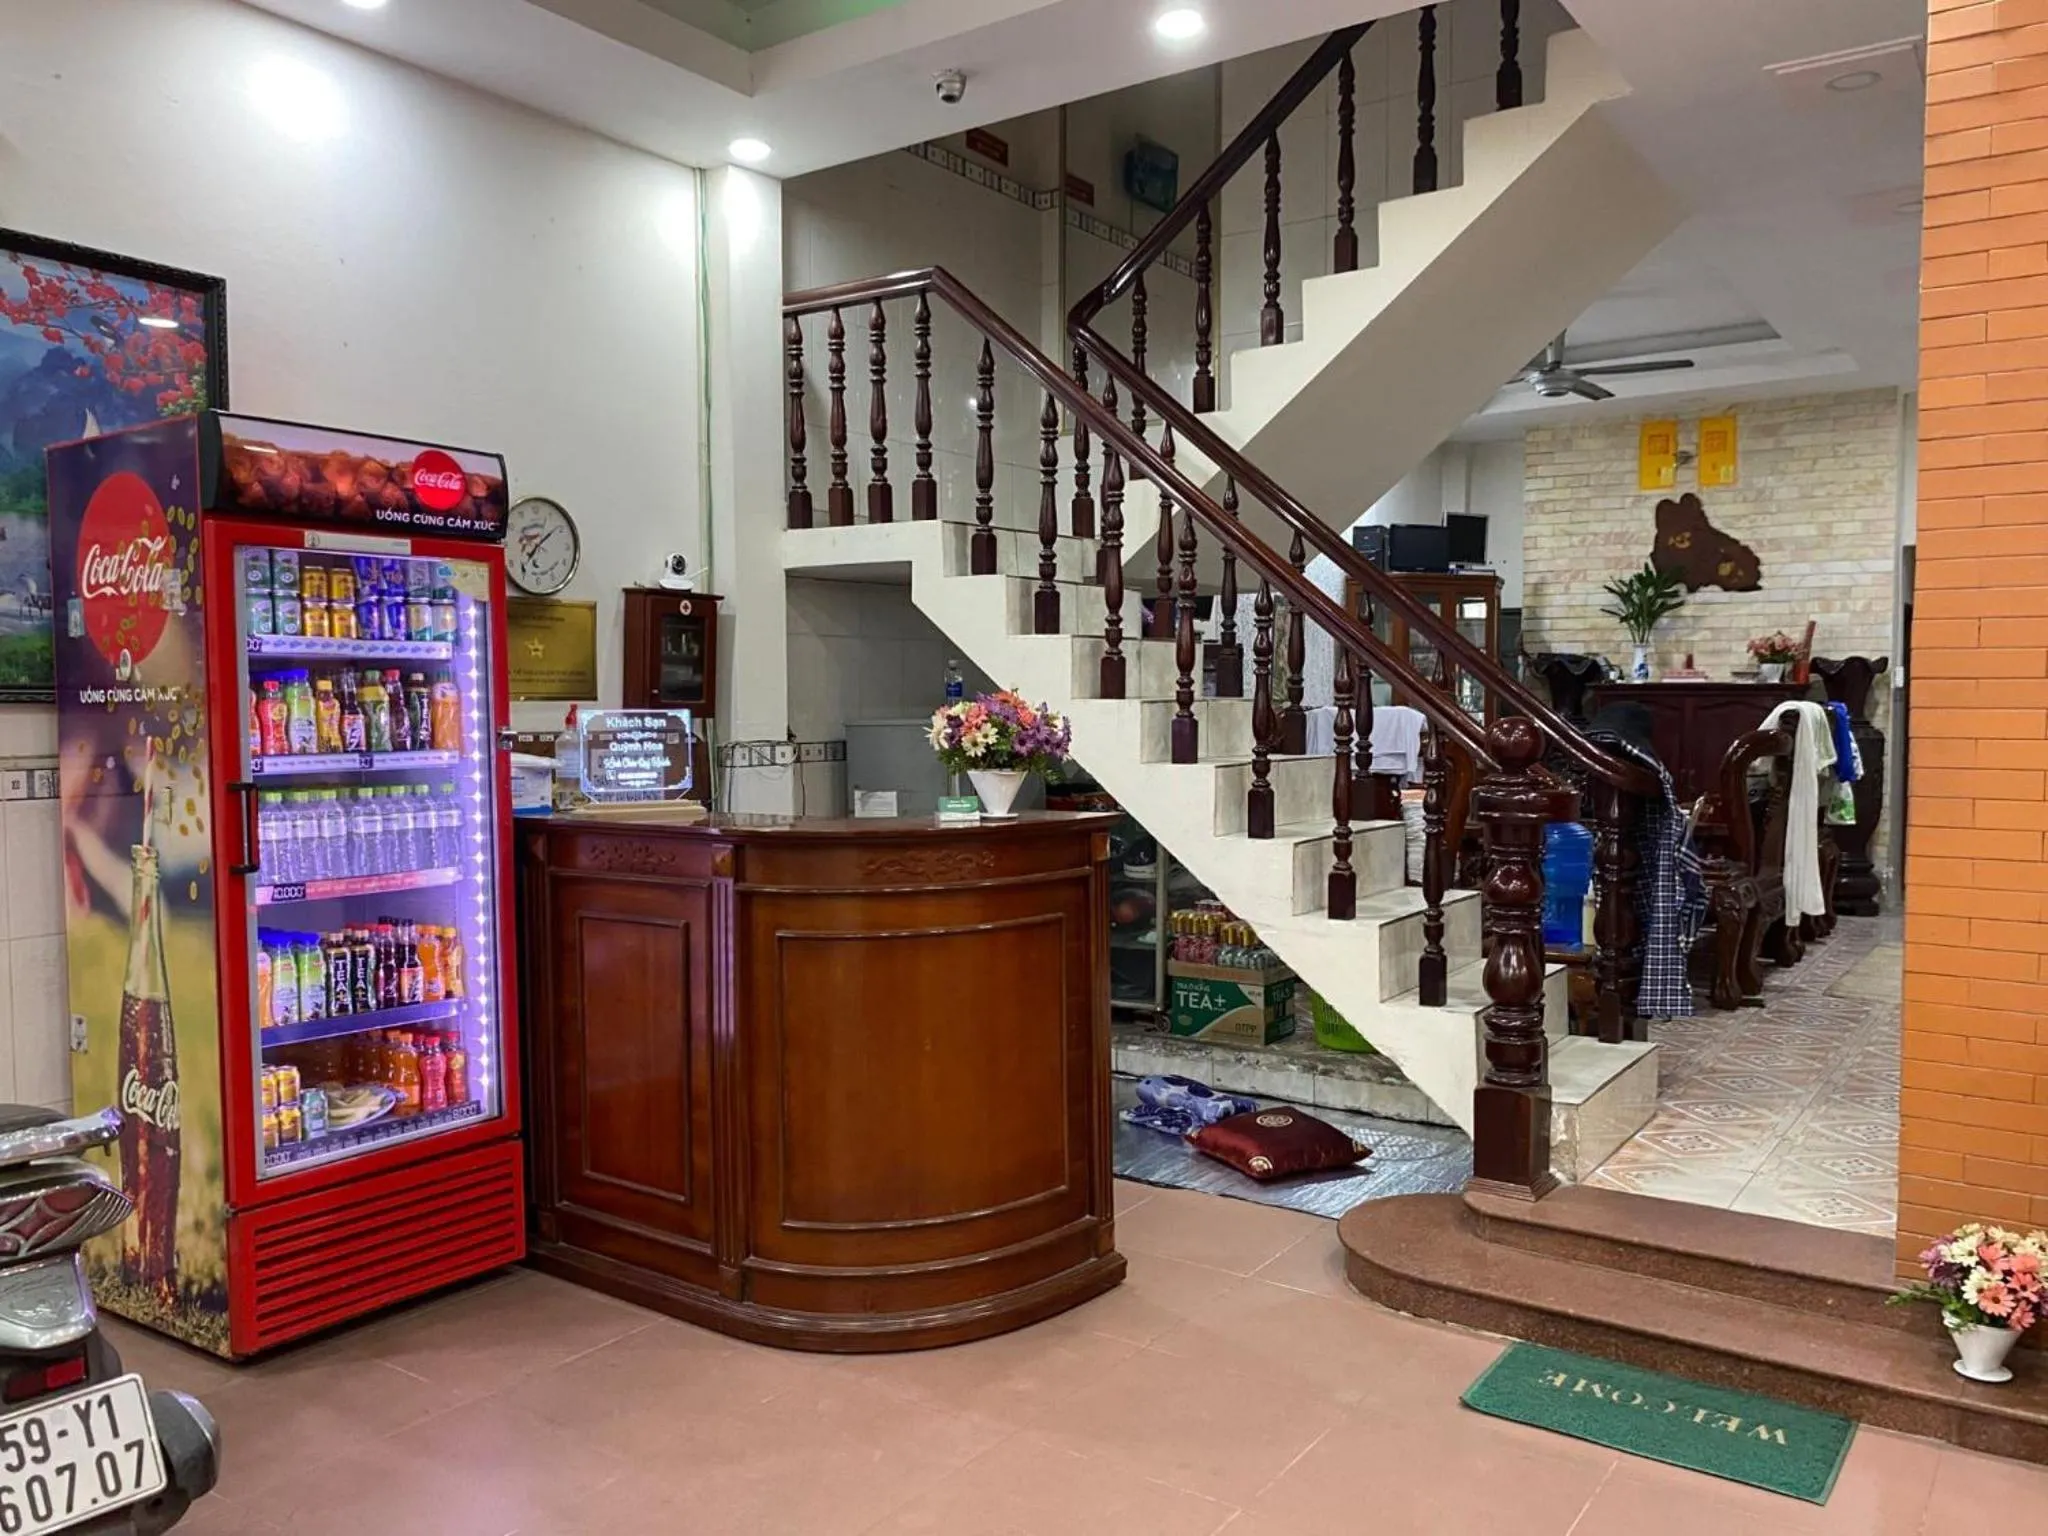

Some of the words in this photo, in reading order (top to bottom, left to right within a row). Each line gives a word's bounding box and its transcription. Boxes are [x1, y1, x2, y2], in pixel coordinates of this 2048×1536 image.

[414, 467, 463, 491] Coca-Cola
[82, 535, 167, 599] Coca-Cola
[1176, 989, 1227, 1012] TEA+
[0, 1393, 120, 1473] 59-Y1
[1538, 1369, 1787, 1446] WELCOME
[0, 1438, 145, 1534] 607.07
